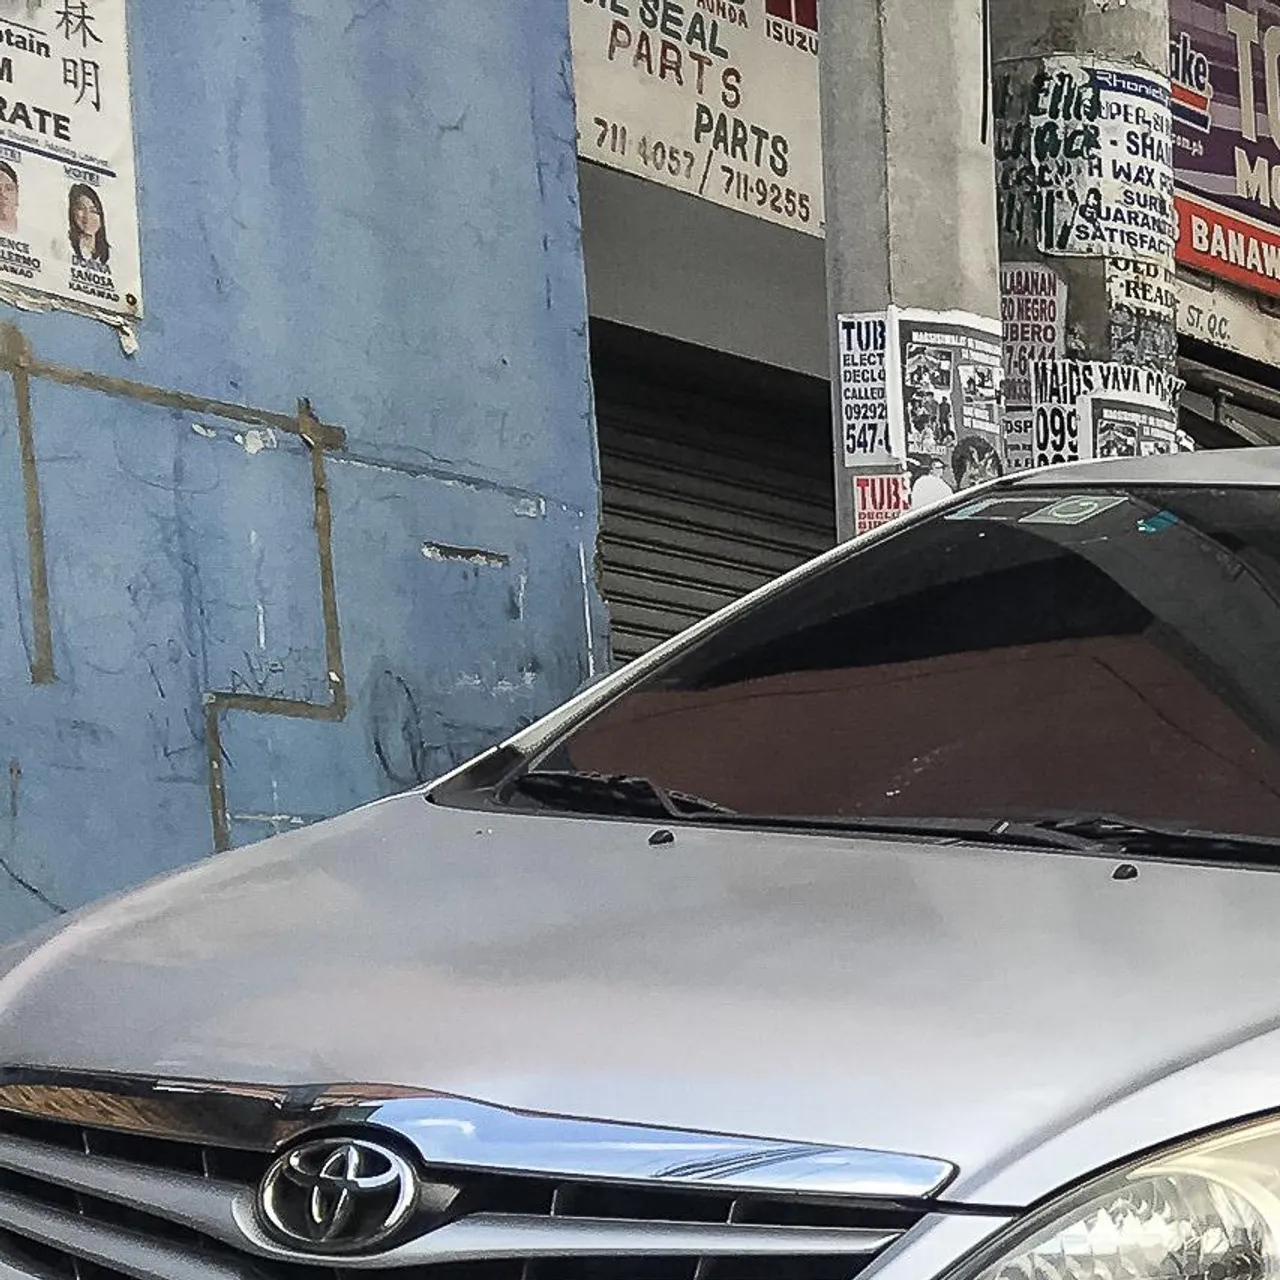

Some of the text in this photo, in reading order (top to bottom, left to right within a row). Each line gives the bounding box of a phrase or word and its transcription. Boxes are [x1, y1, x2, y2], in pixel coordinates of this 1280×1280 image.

[0, 28, 51, 58] tain
[765, 18, 819, 56] ISUZU
[608, 19, 742, 109] PARTS
[694, 102, 789, 178] PARTS
[1111, 158, 1156, 190] WAX
[1074, 223, 1172, 257] SATISFACT
[1016, 298, 1057, 323] NEGRO
[841, 319, 887, 351] TUB
[1032, 361, 1094, 405] MAIDS
[844, 403, 889, 421] 09292
